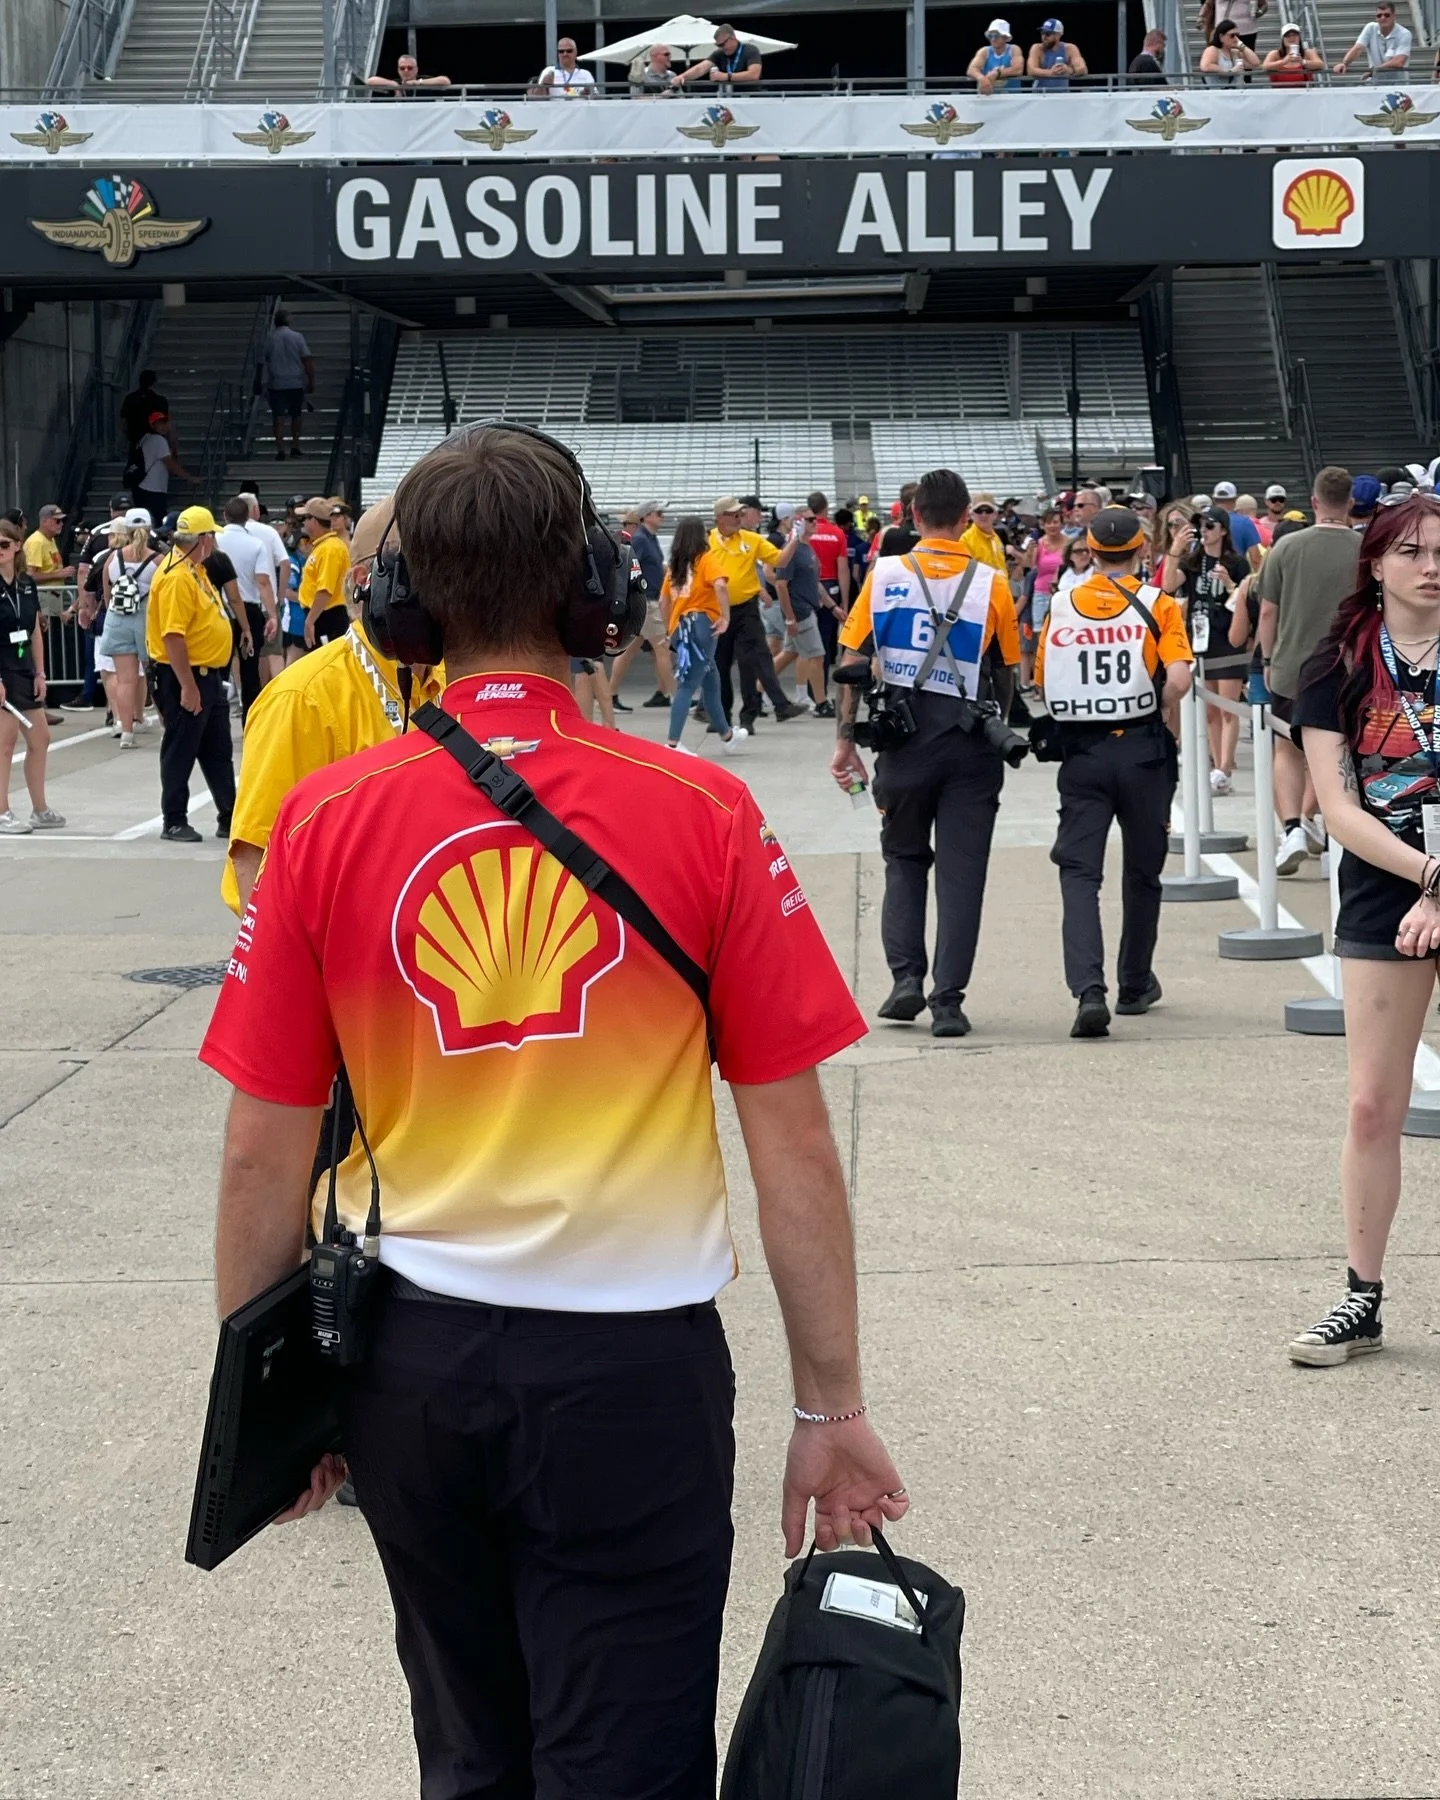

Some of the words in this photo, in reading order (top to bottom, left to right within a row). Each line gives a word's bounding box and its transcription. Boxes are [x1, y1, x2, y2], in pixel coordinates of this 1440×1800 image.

[335, 173, 784, 260] GASOLINE
[837, 168, 1114, 253] ALLEY
[52, 229, 107, 239] INDIANAPOLIS
[120, 215, 130, 258] MOTOR
[138, 229, 181, 239] SPEEDWAY
[911, 612, 936, 649] 6
[884, 661, 917, 677] PHOTO
[1078, 650, 1131, 685] 158
[484, 683, 523, 691] TEAM
[1050, 691, 1154, 716] PHOTO
[1413, 727, 1432, 753] PRIX
